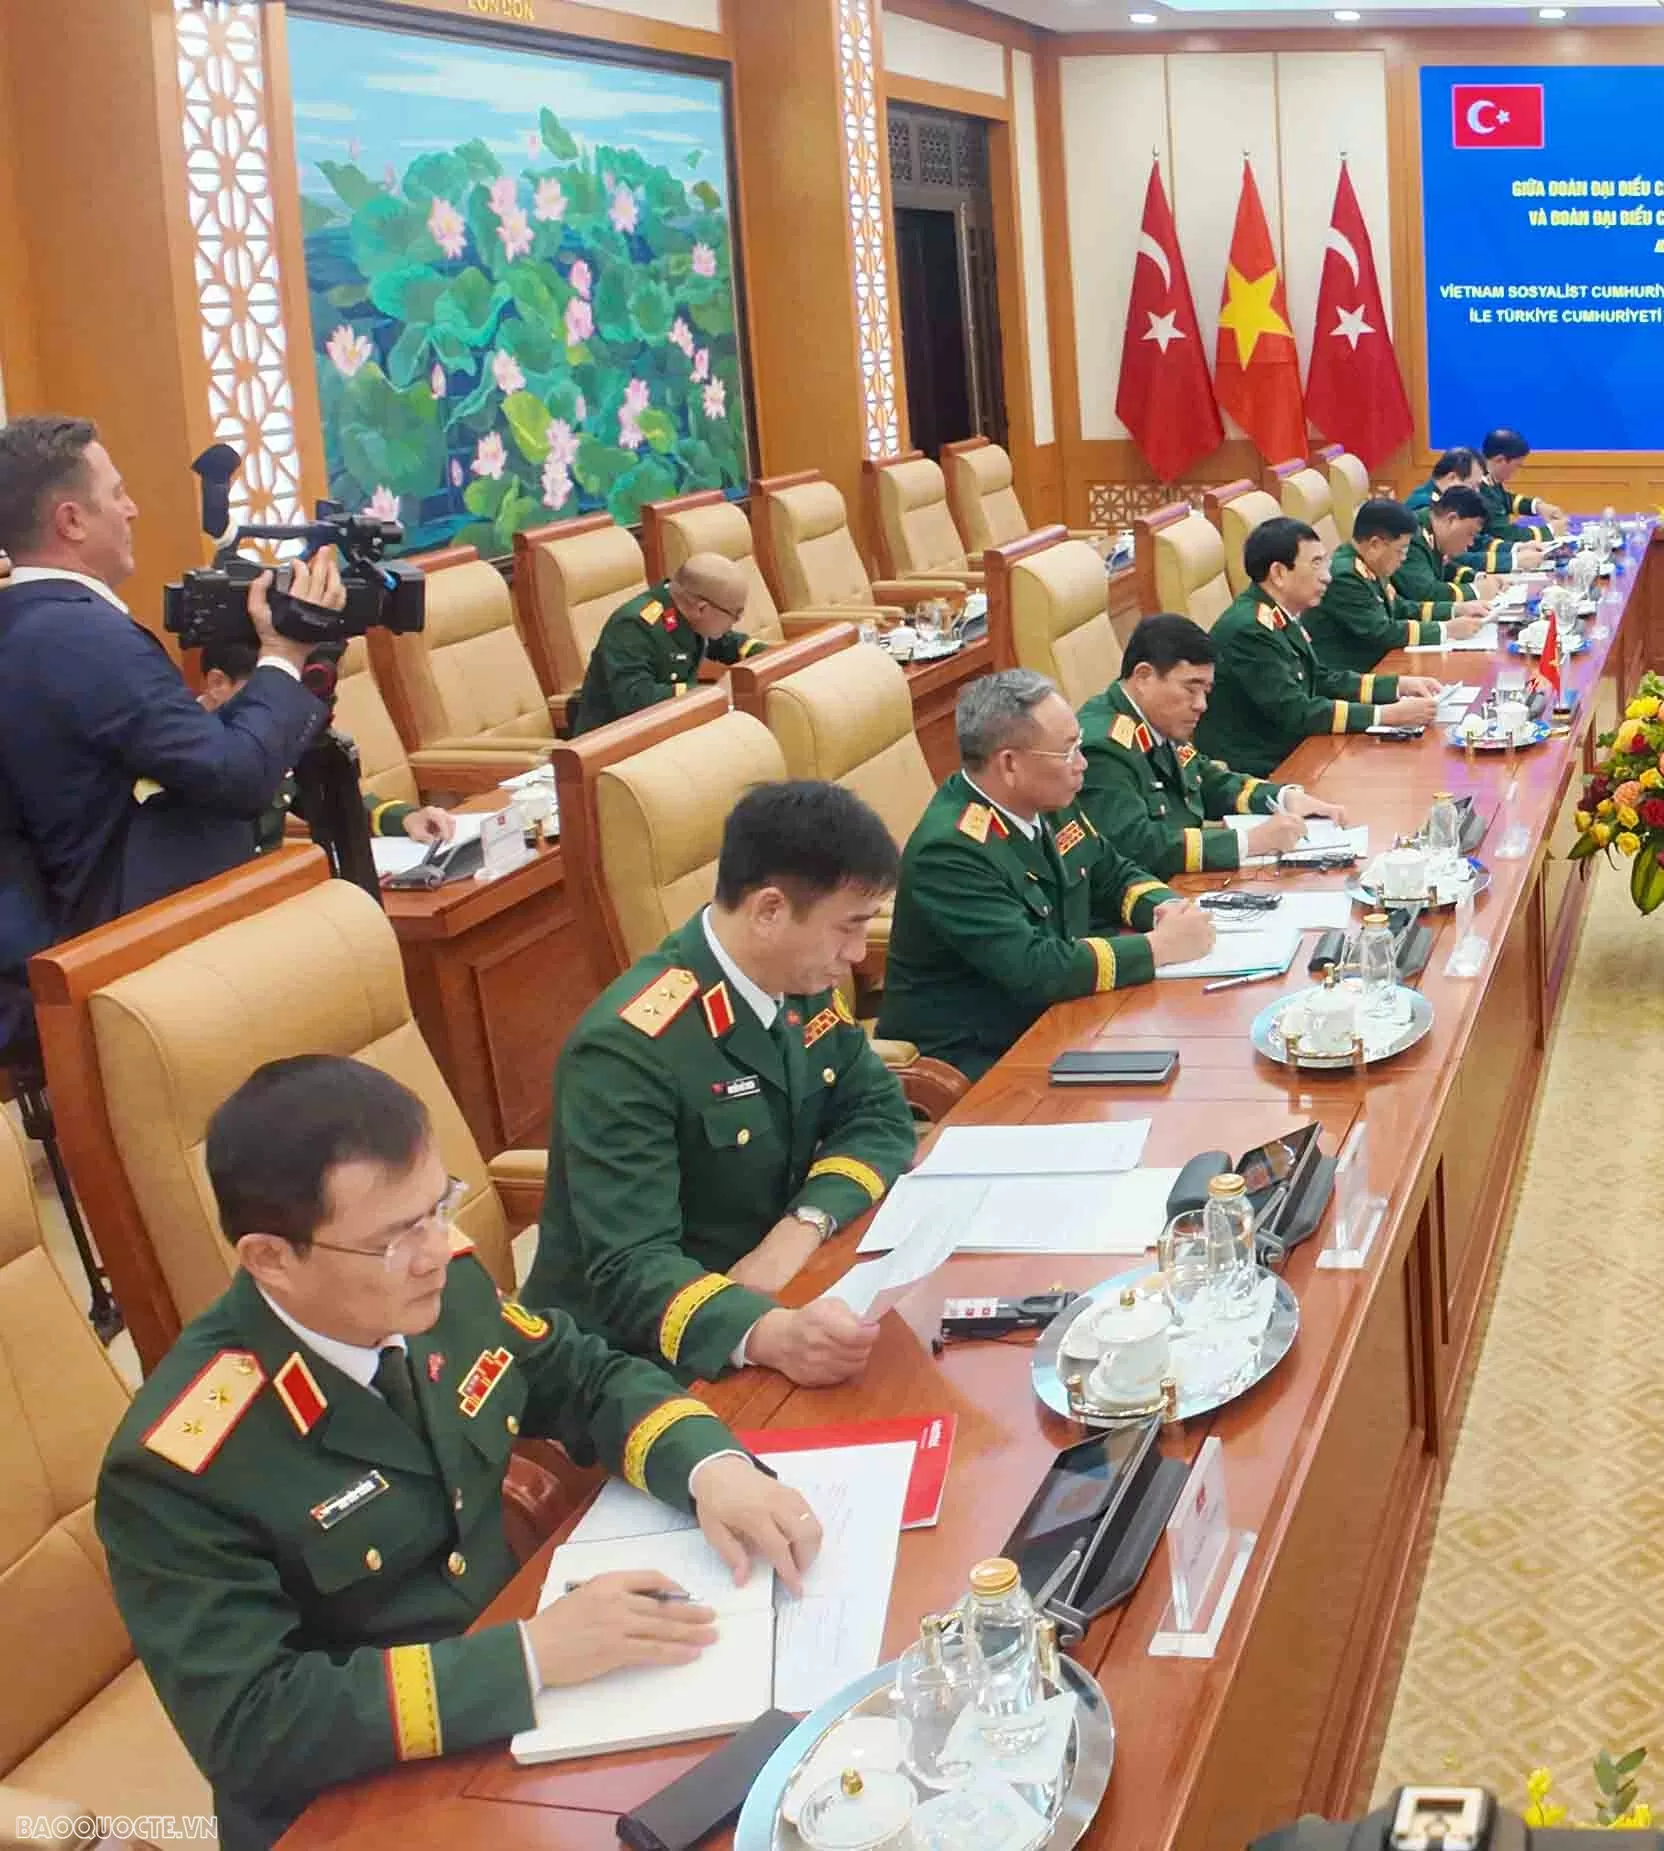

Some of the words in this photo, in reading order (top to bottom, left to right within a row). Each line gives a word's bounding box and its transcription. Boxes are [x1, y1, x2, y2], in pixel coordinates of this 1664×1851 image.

[1528, 207, 1548, 226] VÀ
[1507, 283, 1588, 299] SOSYALİST
[1495, 307, 1558, 323] TÜRKİYE
[1561, 307, 1662, 323] CUMHURİYETİ
